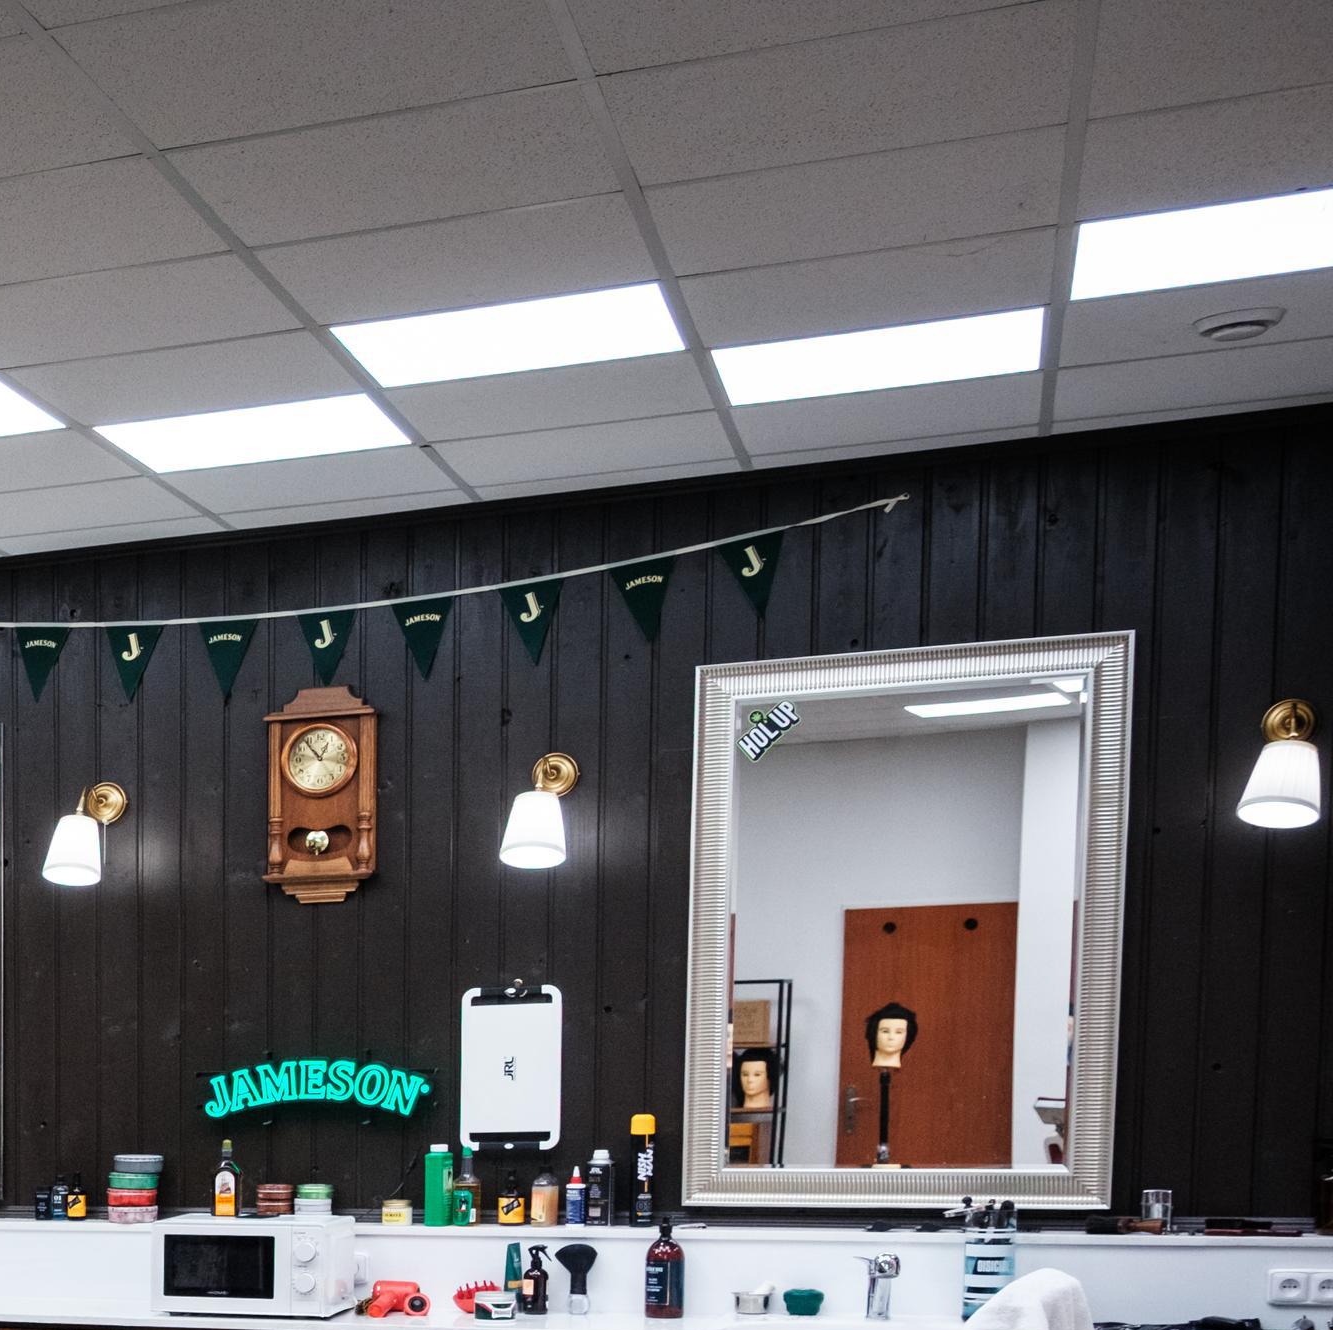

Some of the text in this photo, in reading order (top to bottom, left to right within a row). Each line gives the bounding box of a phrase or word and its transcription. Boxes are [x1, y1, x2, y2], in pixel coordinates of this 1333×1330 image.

[741, 545, 764, 577] J
[624, 574, 664, 590] JAMESON
[404, 612, 441, 627] JAMESON
[520, 591, 541, 622] J
[25, 639, 57, 649] JAMESON
[121, 632, 141, 661] J
[208, 632, 243, 645] JAMESON
[314, 619, 334, 649] J
[204, 1058, 429, 1120] JAMESON
